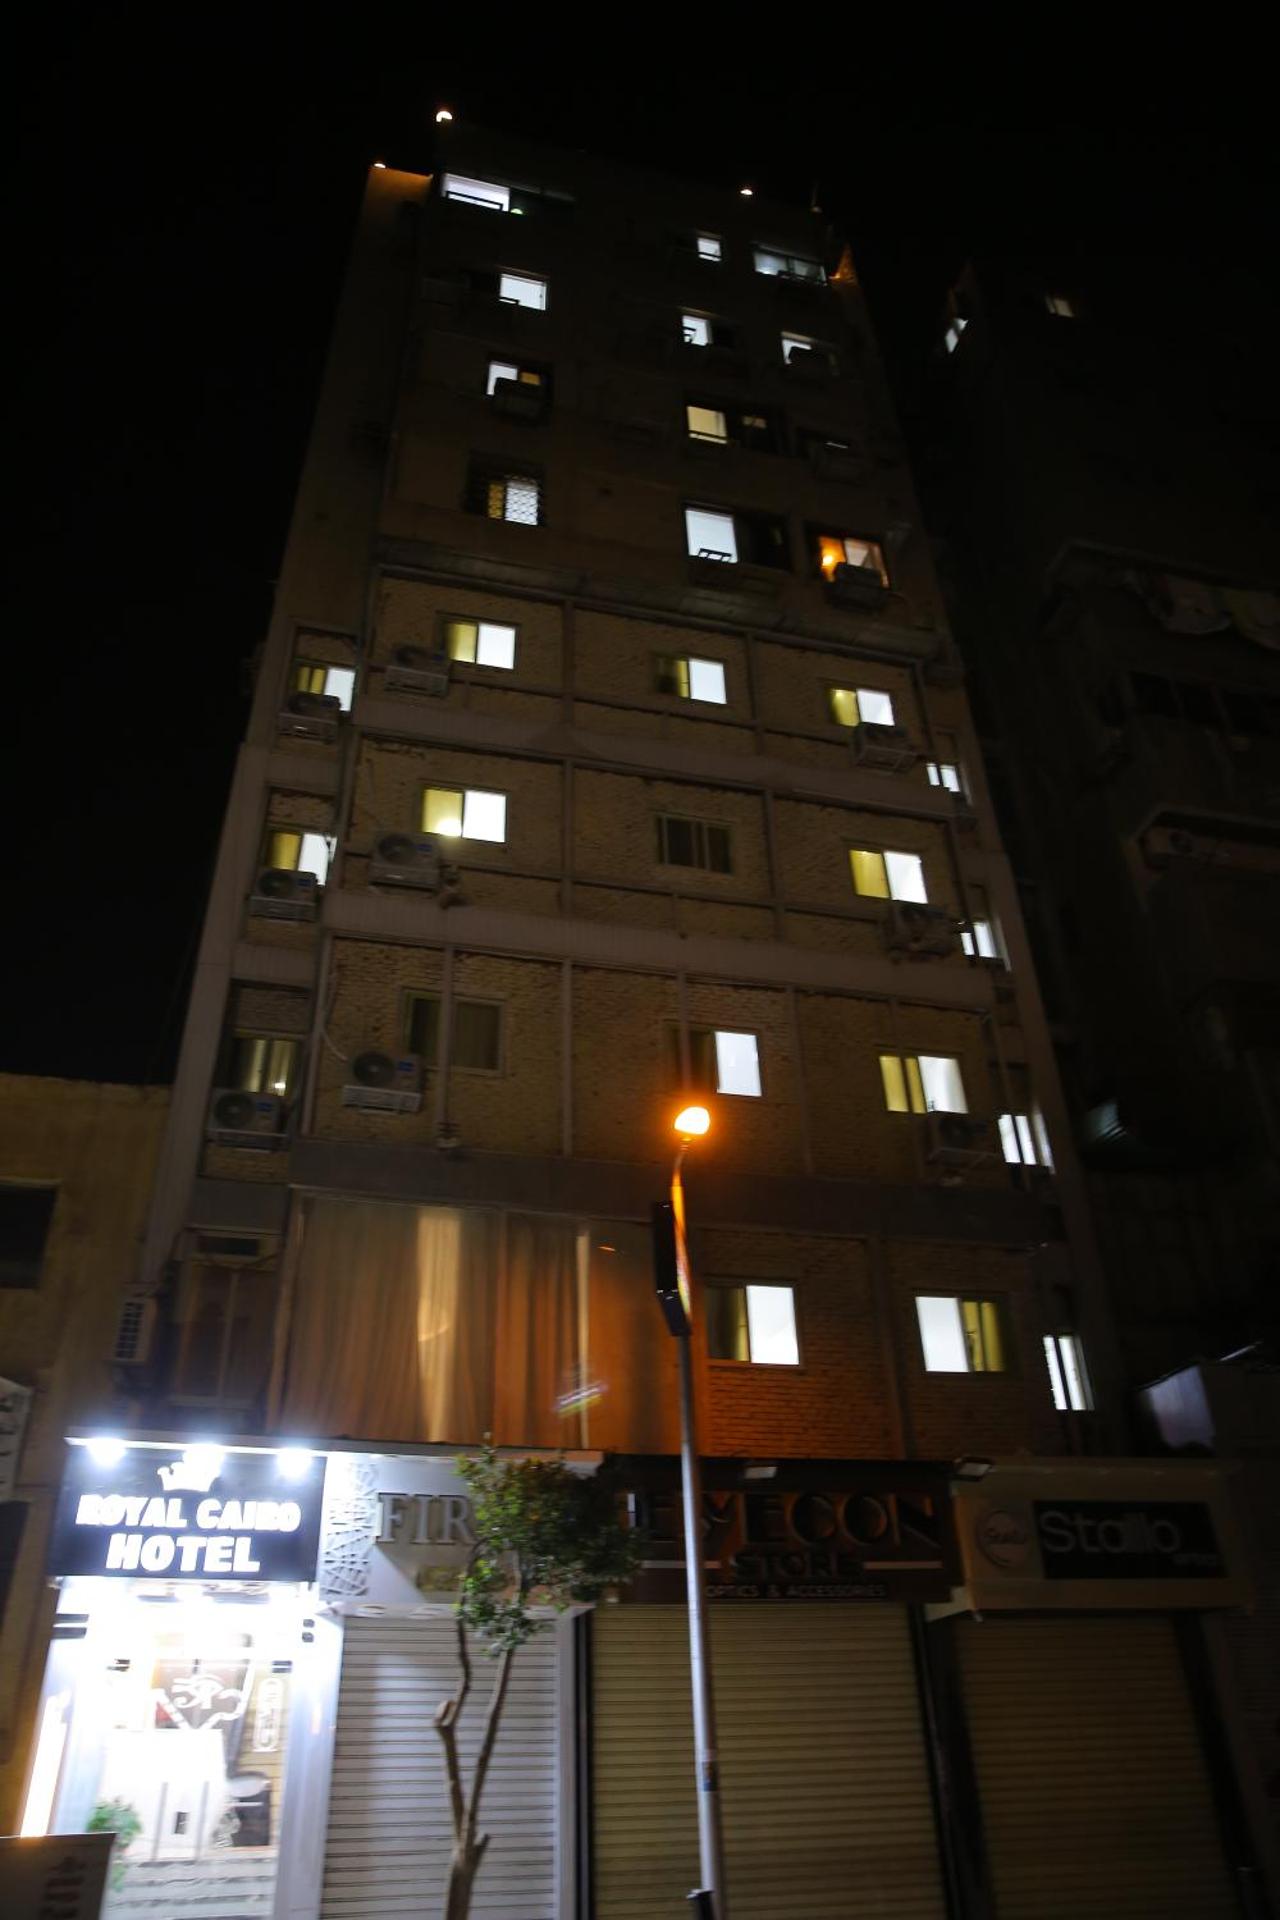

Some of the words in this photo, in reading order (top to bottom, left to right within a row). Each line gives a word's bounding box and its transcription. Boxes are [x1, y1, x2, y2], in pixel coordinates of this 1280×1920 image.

[76, 1494, 188, 1528] ROYAL
[196, 1499, 302, 1532] CAIRO
[105, 1533, 261, 1573] HOTEL
[733, 1552, 864, 1584] STORE
[704, 1584, 760, 1598] OPTICS
[768, 1585, 782, 1598] &
[786, 1584, 888, 1598] ACCESSORIES
